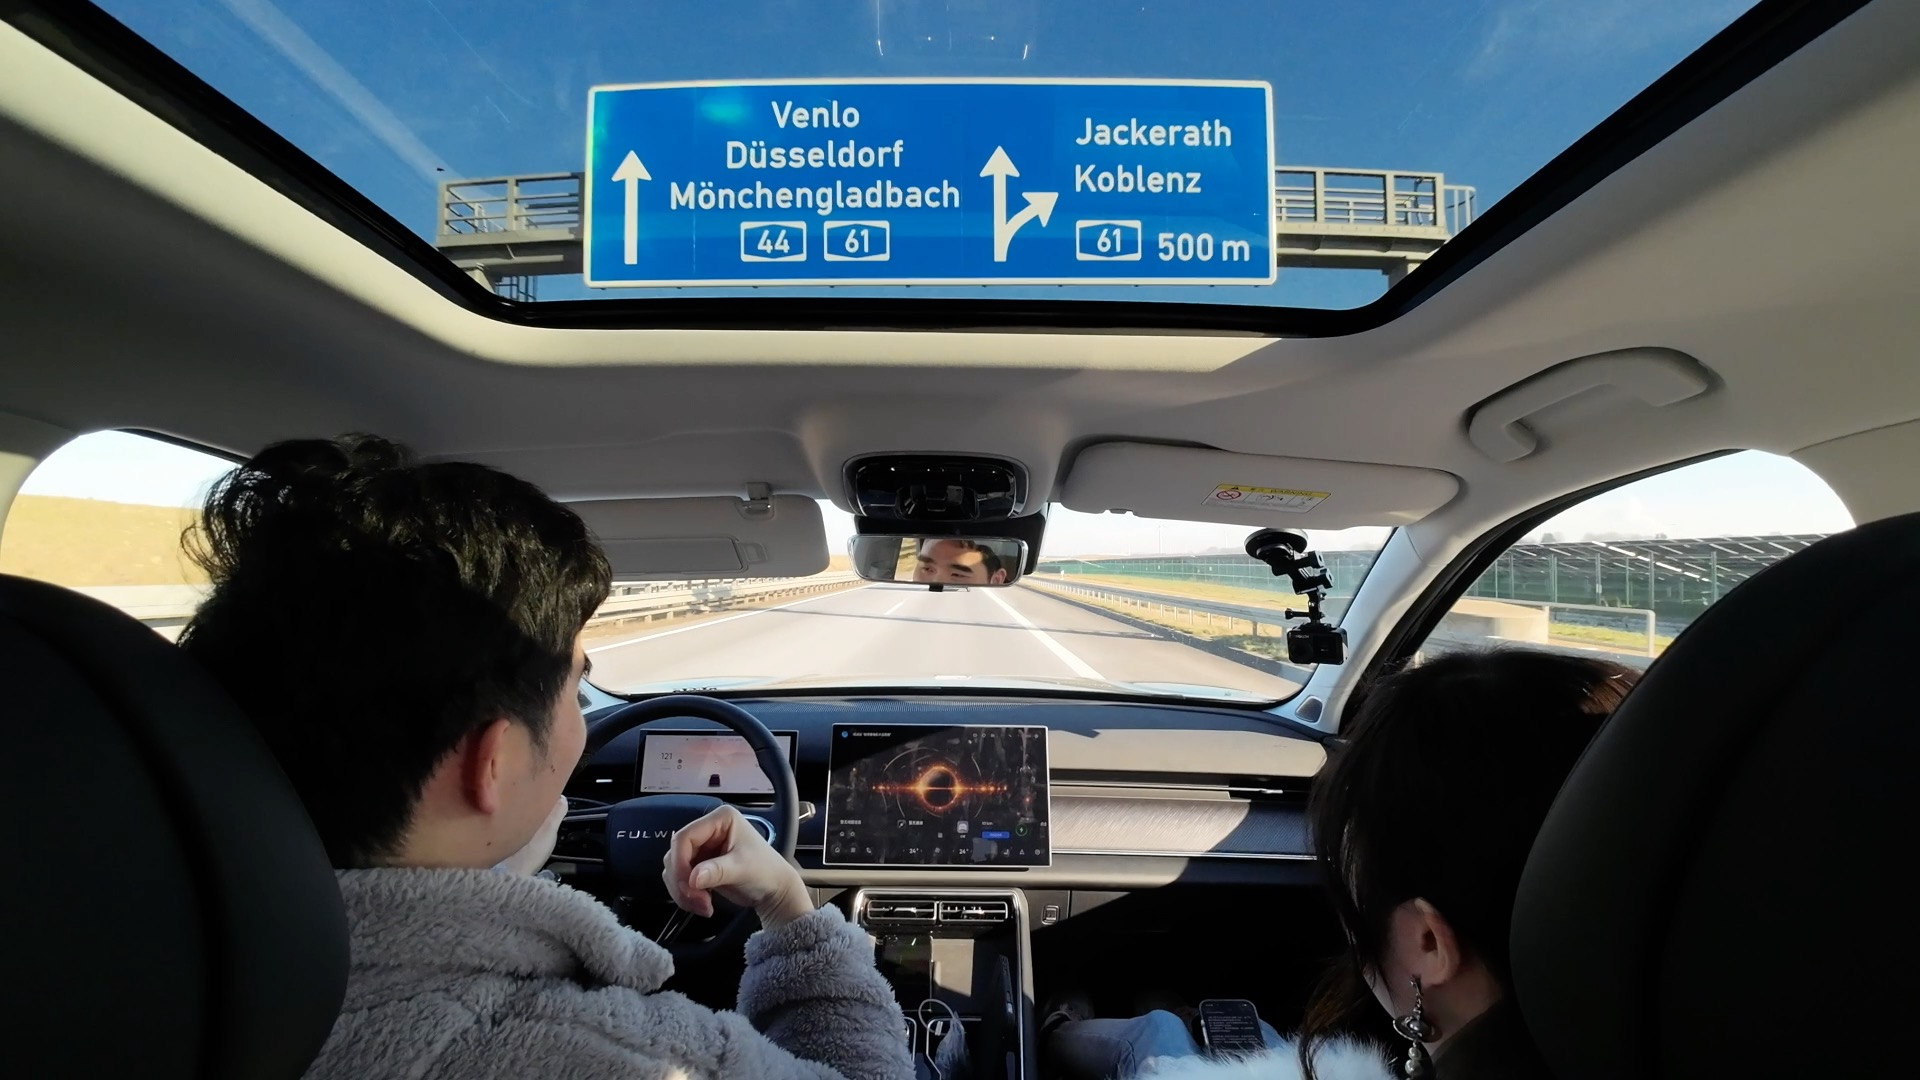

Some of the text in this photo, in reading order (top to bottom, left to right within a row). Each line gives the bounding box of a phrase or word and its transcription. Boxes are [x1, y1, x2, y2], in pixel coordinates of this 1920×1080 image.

[771, 100, 860, 129] Venlo
[1075, 117, 1232, 147] Jackerath
[726, 139, 904, 169] Düsseldorf
[1075, 164, 1202, 193] Koblenz
[670, 179, 960, 216] Mönchengladbach
[757, 229, 790, 253] 44
[845, 229, 869, 253] 61
[1097, 228, 1121, 253] 61
[1158, 232, 1250, 262] 500 m
